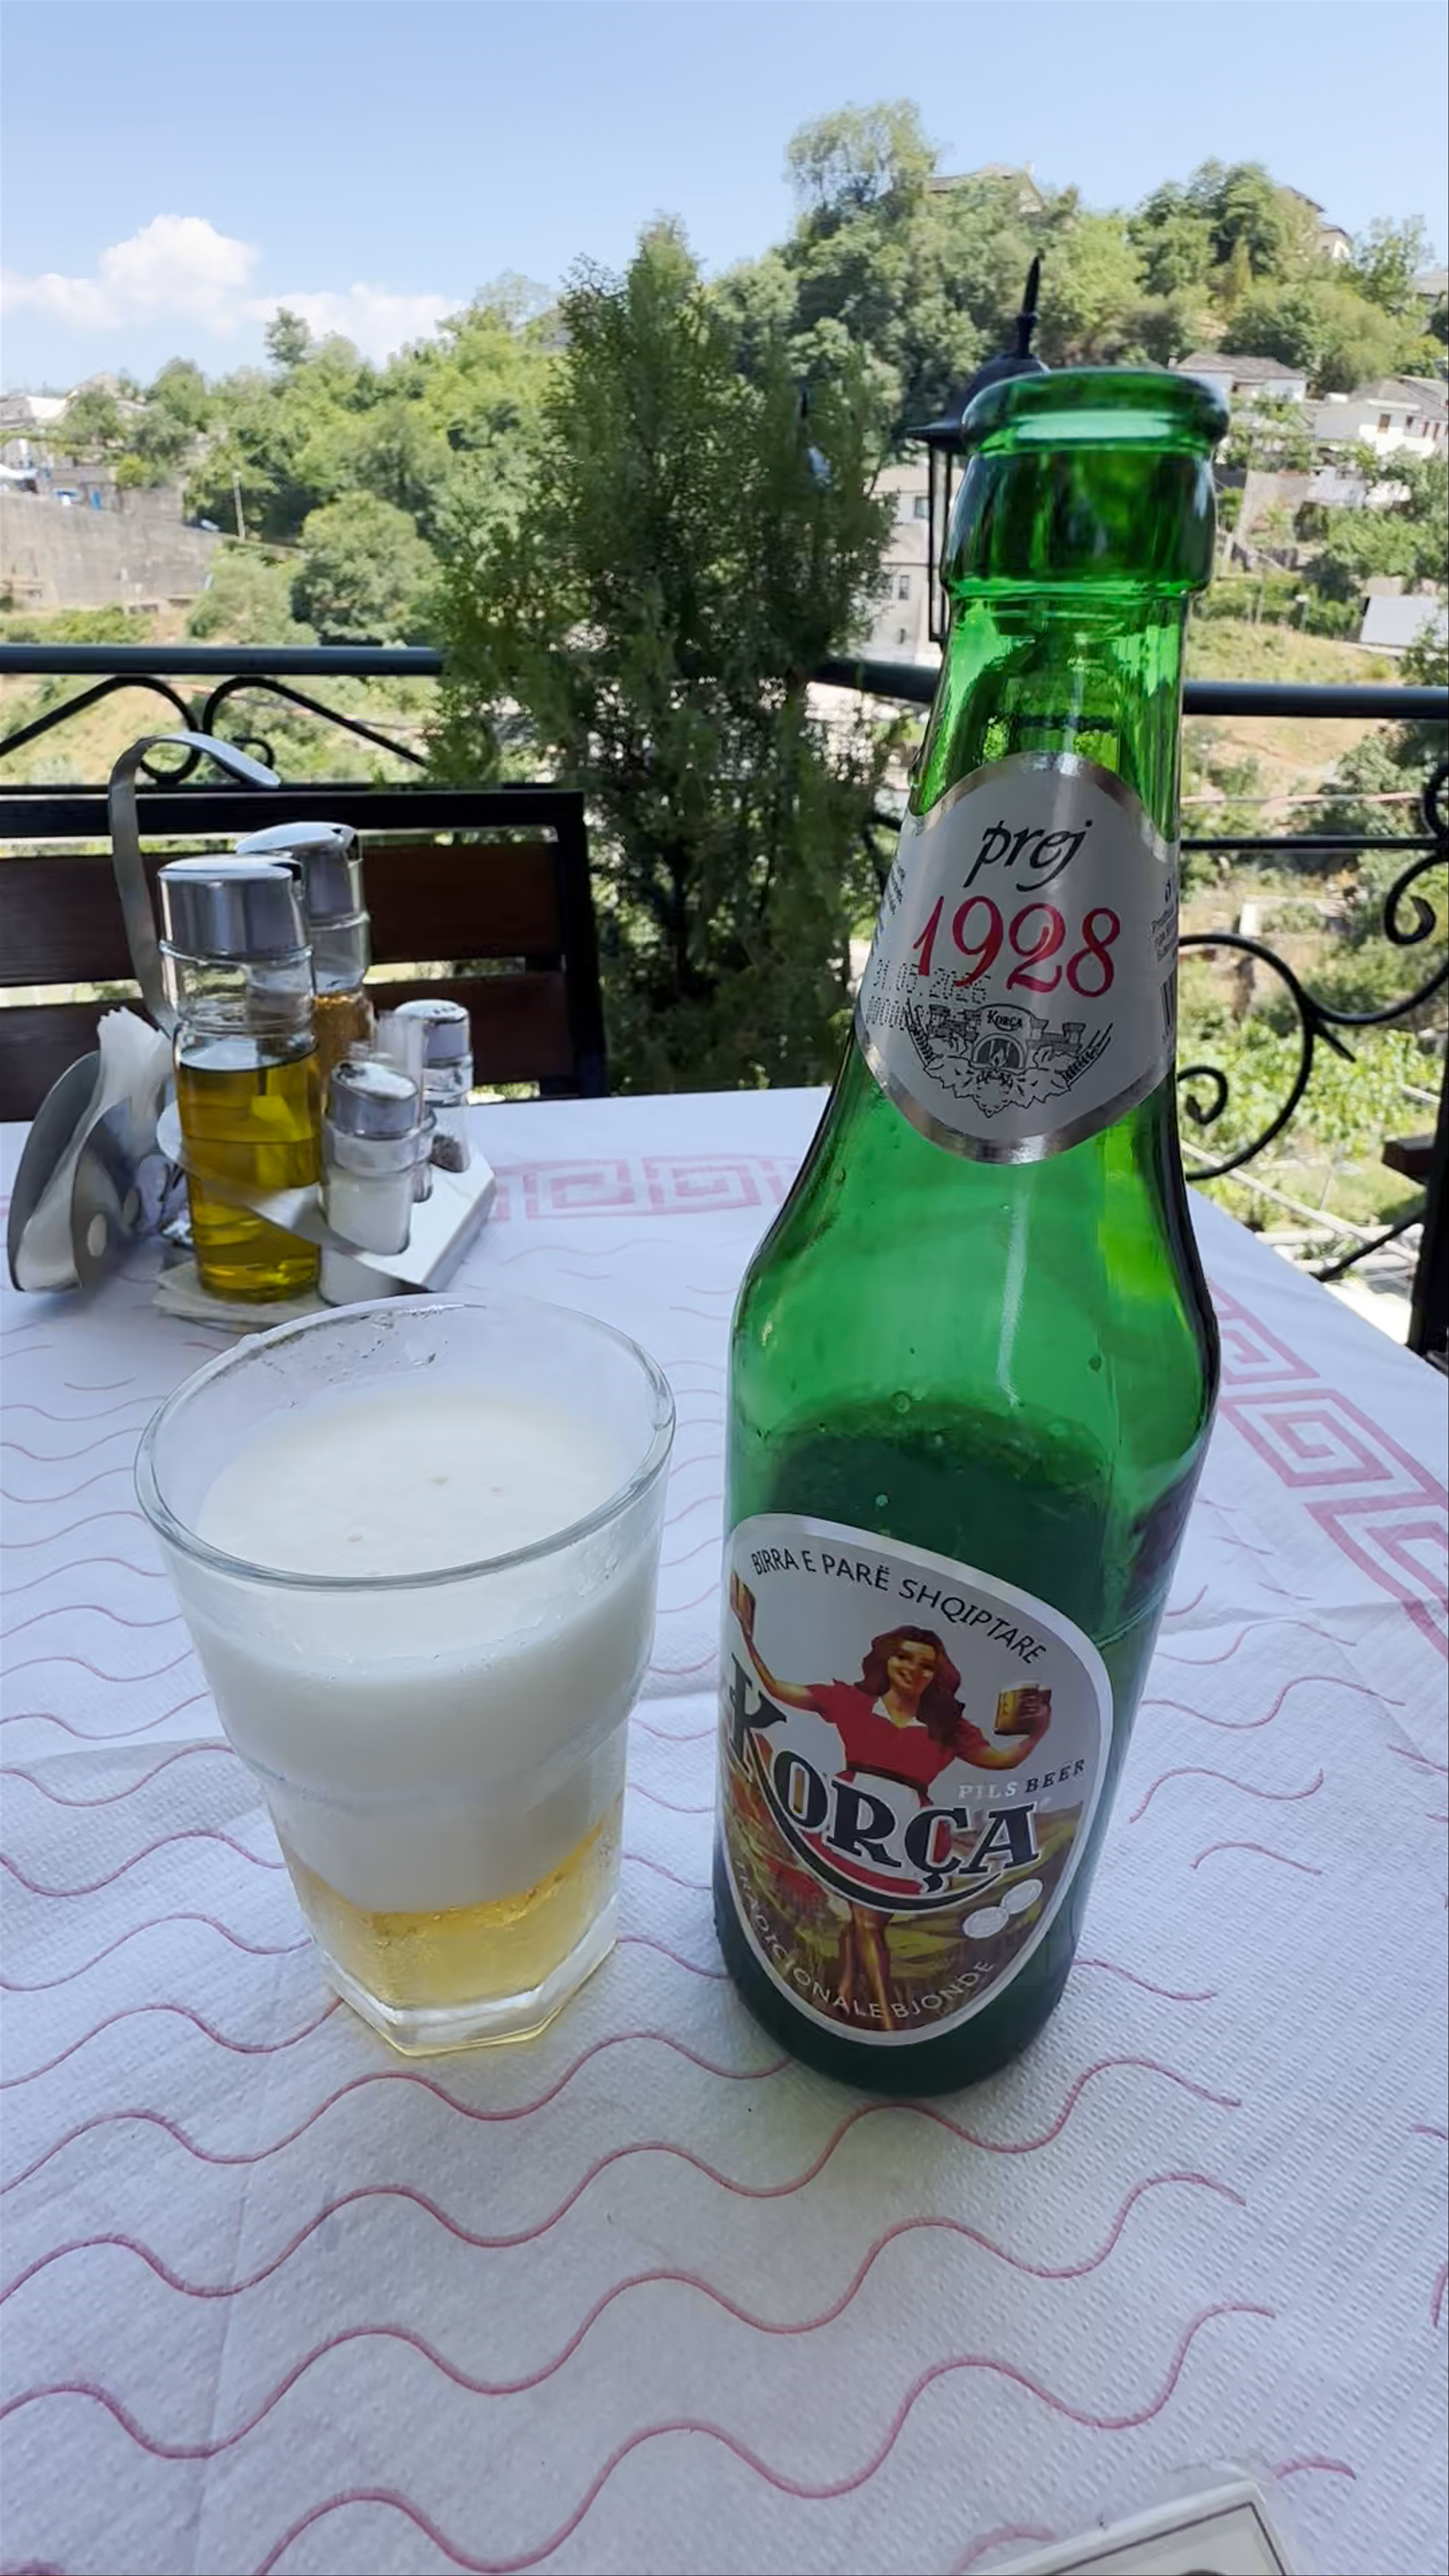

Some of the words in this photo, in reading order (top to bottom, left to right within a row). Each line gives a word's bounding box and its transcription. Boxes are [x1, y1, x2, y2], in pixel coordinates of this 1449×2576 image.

[962, 820, 1093, 892] prej
[912, 895, 1120, 997] 1928
[751, 1548, 800, 1575] BIRRA
[801, 1550, 817, 1572] E
[821, 1553, 890, 1591] PARË
[898, 1579, 1047, 1664] SHQIPTARE
[729, 1652, 1040, 1895] KORÇA
[958, 1781, 1018, 1799] PILS
[1024, 1759, 1085, 1793] BEER
[734, 1859, 884, 2018] TRADICIONALE
[891, 1961, 995, 2018] BJONDE
